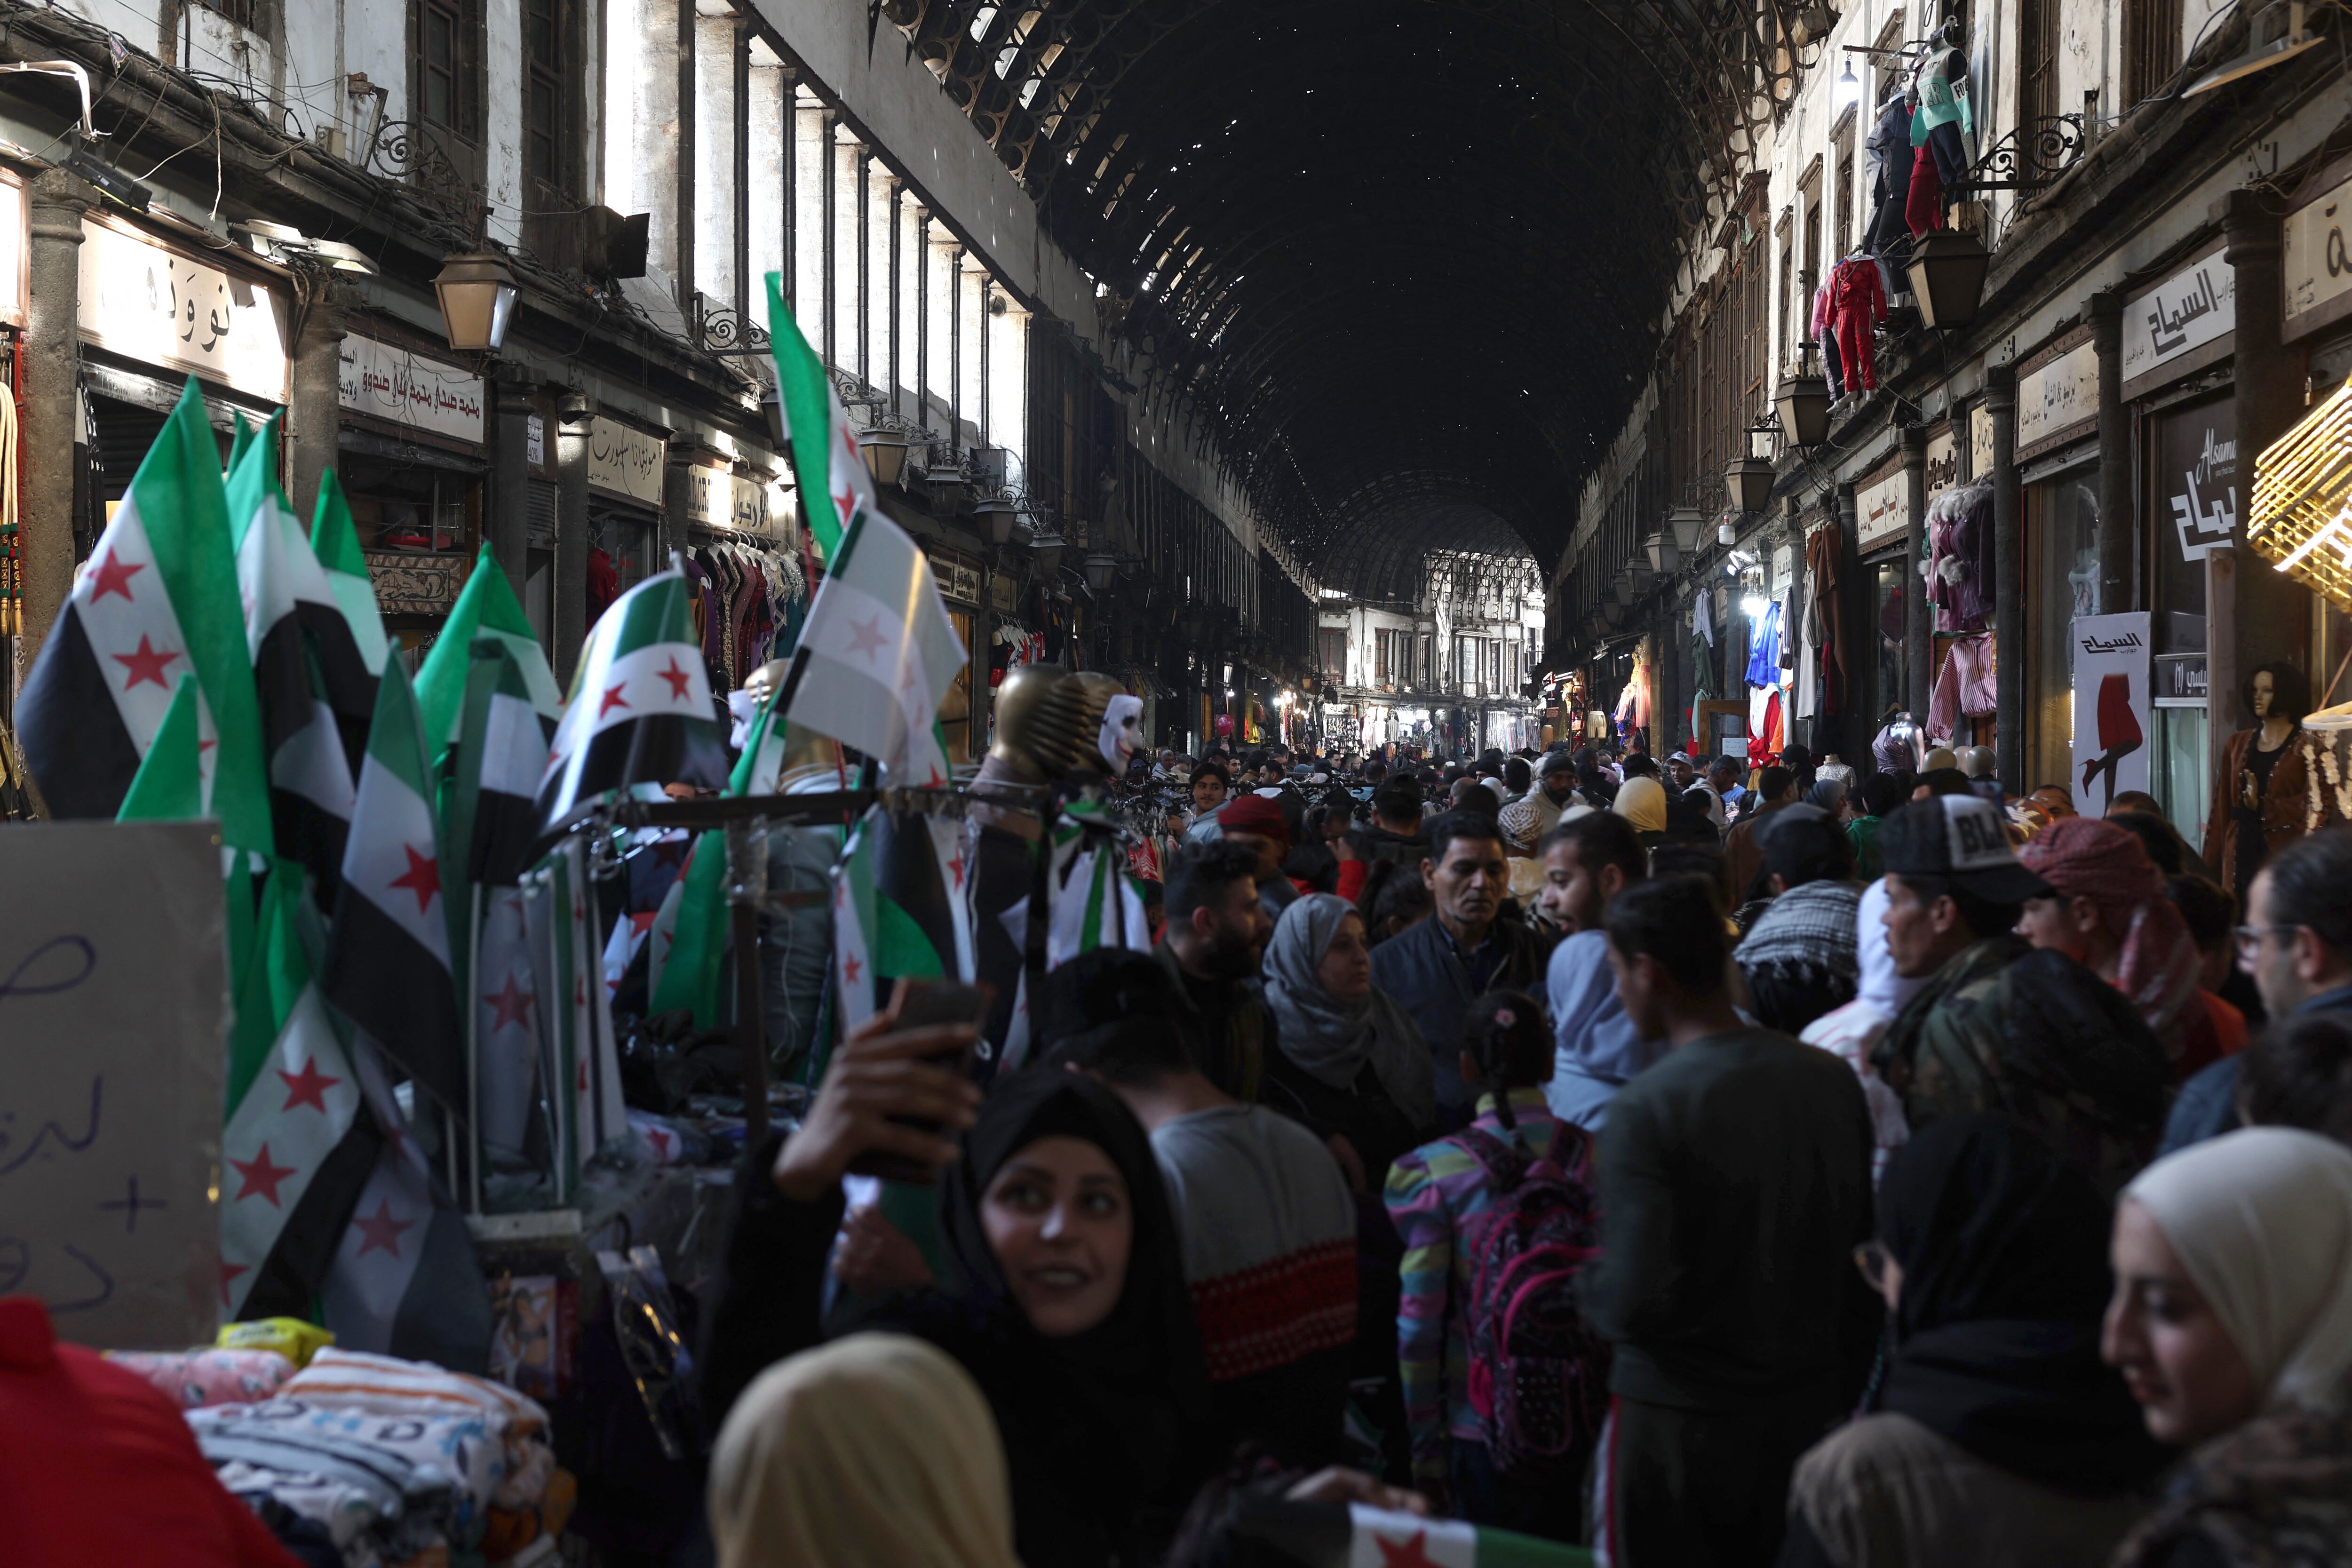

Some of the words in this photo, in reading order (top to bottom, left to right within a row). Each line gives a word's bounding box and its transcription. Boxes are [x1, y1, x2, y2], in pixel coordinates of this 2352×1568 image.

[2147, 268, 2218, 356] السماح
[363, 365, 389, 392] صندوق
[410, 383, 431, 407] محمد
[459, 397, 480, 419] محمد
[528, 446, 538, 462] 40%
[2081, 633, 2143, 654] السماح
